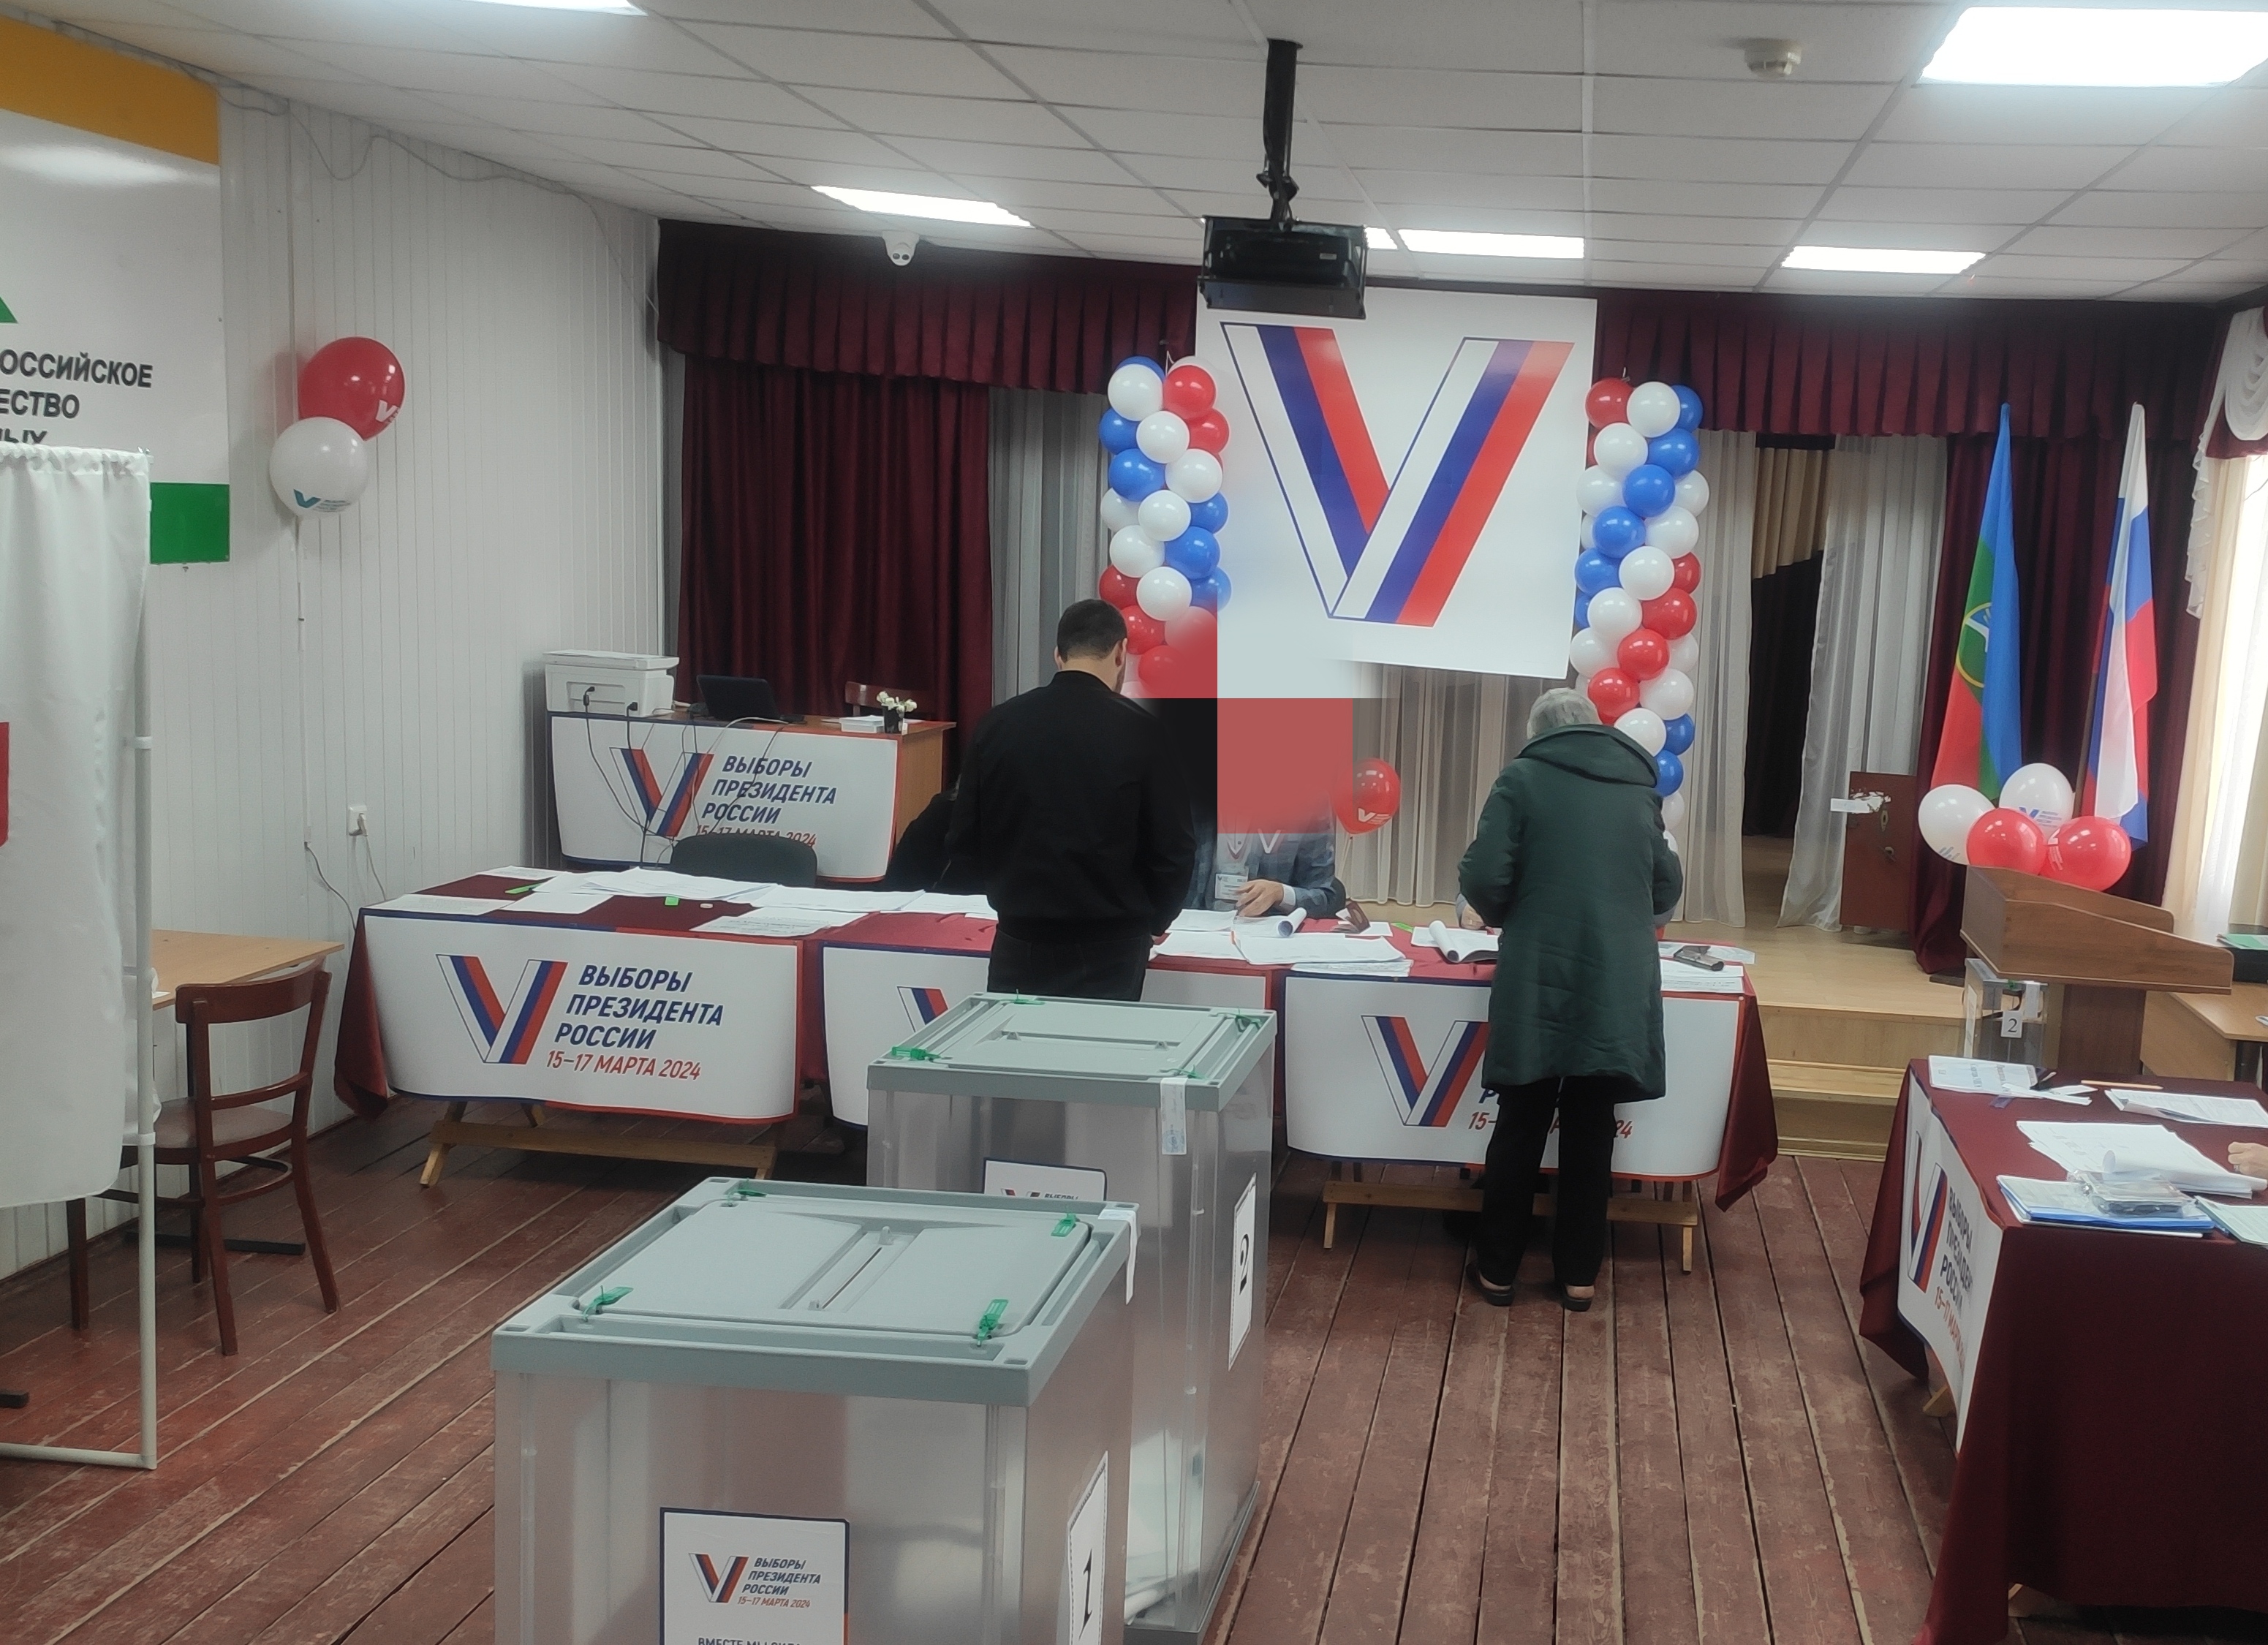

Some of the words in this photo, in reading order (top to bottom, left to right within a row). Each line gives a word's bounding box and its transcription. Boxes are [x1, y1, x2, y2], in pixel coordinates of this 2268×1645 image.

[0, 349, 153, 388] ОССИЙСКОЕ
[0, 388, 80, 419] ЕСТВО
[722, 755, 812, 778] ВЫБОРЫ
[711, 779, 837, 804] ПРЕЗИДЕНТА
[701, 803, 782, 824] РОССИИ
[578, 964, 693, 992] ВЫБОРЫ
[566, 994, 724, 1026] ПРЕЗИДЕНТА
[554, 1023, 657, 1050] РОССИИ
[2008, 1018, 2018, 1032] 2
[547, 1050, 594, 1072] 15–17
[593, 1054, 657, 1076] МАРТА
[658, 1059, 701, 1081] 2024
[1949, 1187, 1973, 1254] ВЫБОРЫ
[754, 1557, 806, 1570] ВЫБОРЫ
[741, 1584, 790, 1595] РОССИИ
[747, 1570, 821, 1584] ПРЕЗИДЕНТА
[761, 1597, 788, 1607] МАРТА
[790, 1600, 811, 1608] 2024
